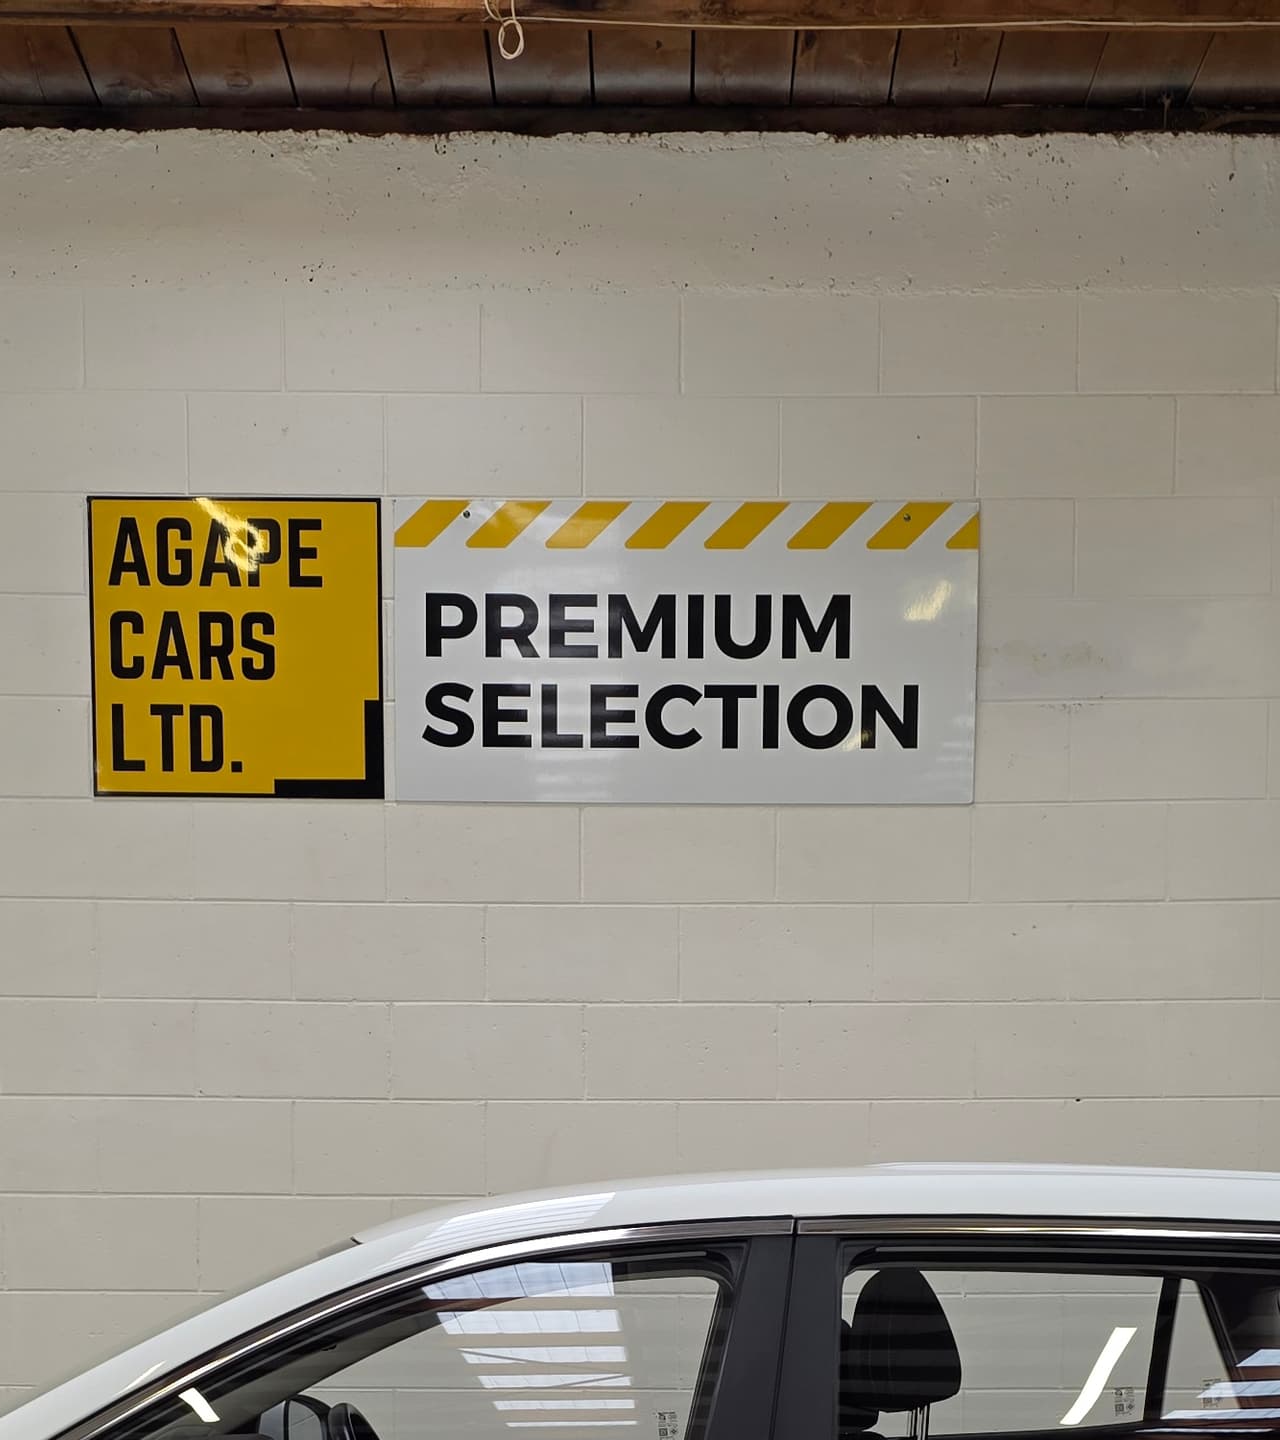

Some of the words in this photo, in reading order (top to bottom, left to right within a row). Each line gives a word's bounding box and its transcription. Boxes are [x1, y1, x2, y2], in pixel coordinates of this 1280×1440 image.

[108, 516, 323, 588] AGAPE
[109, 610, 276, 681] CARS
[425, 592, 851, 660] PREMIUM
[111, 703, 243, 773] LTD.
[421, 682, 919, 750] SELECTION
